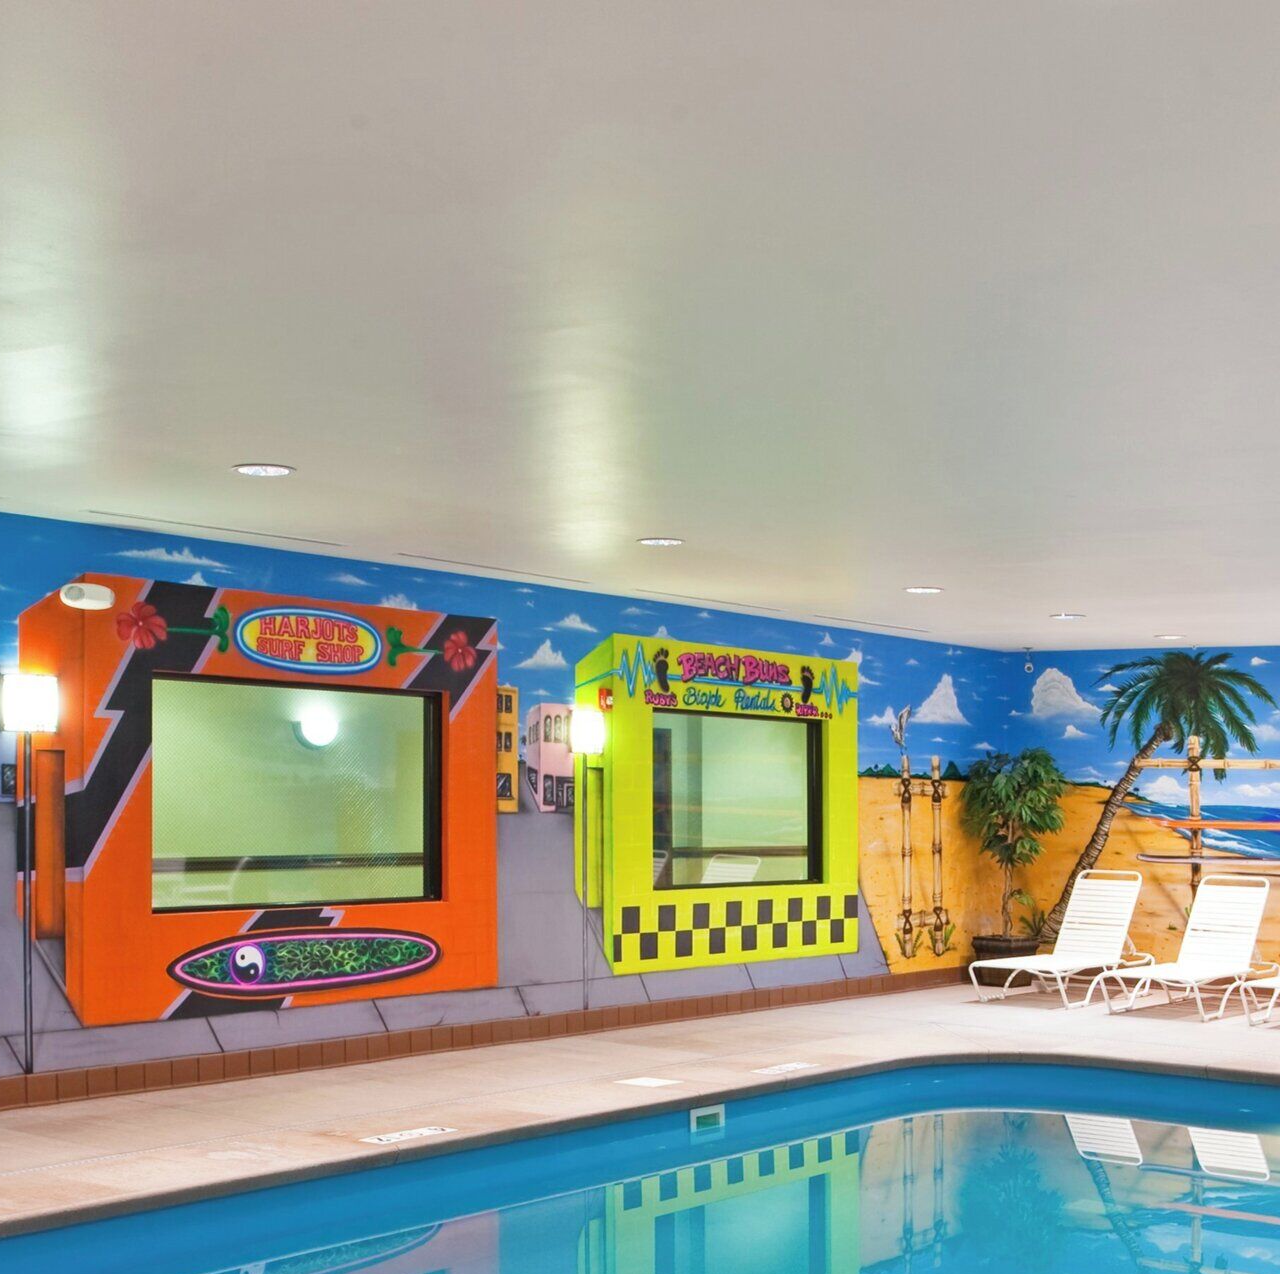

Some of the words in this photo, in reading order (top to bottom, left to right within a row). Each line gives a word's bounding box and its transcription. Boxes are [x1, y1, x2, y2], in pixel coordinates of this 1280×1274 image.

[256, 637, 305, 661] SURF
[316, 642, 364, 664] SHOP
[677, 652, 741, 682] BEACH
